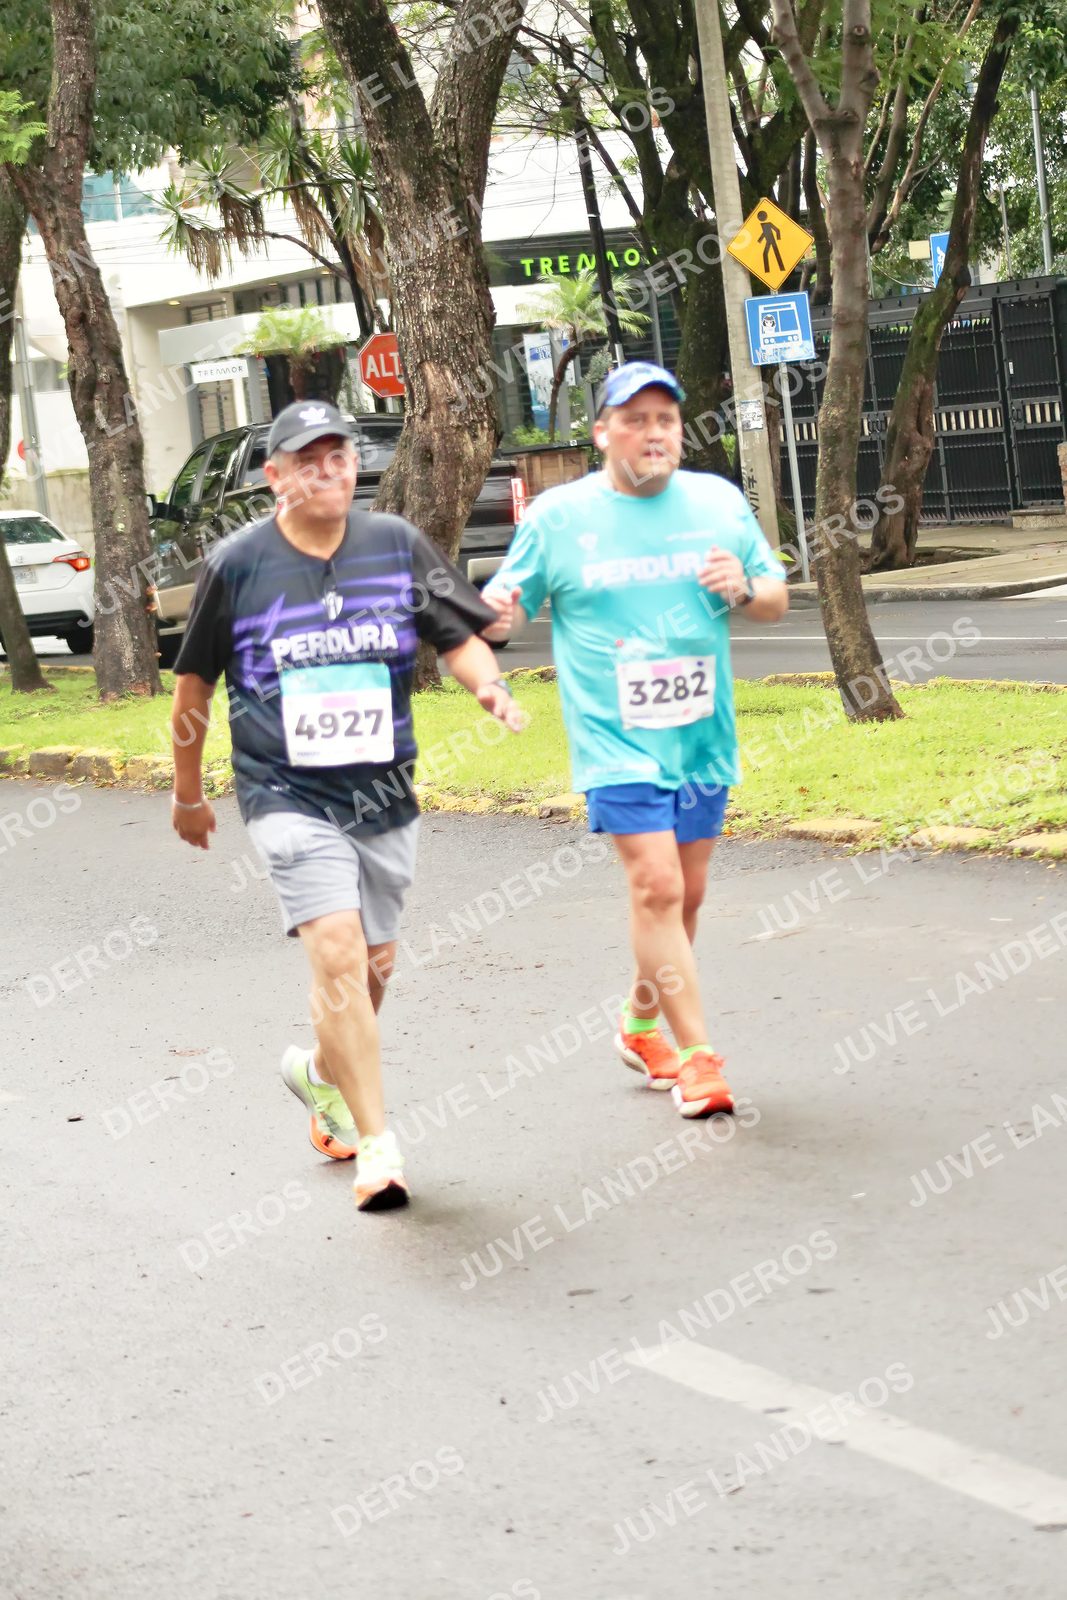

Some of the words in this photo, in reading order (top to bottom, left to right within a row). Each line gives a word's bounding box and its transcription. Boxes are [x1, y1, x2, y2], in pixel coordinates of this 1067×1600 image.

[365, 351, 405, 380] ALT
[581, 551, 708, 589] PERDUR
[271, 623, 398, 668] PERDURA
[628, 670, 708, 706] 3282
[295, 708, 384, 741] 4927
